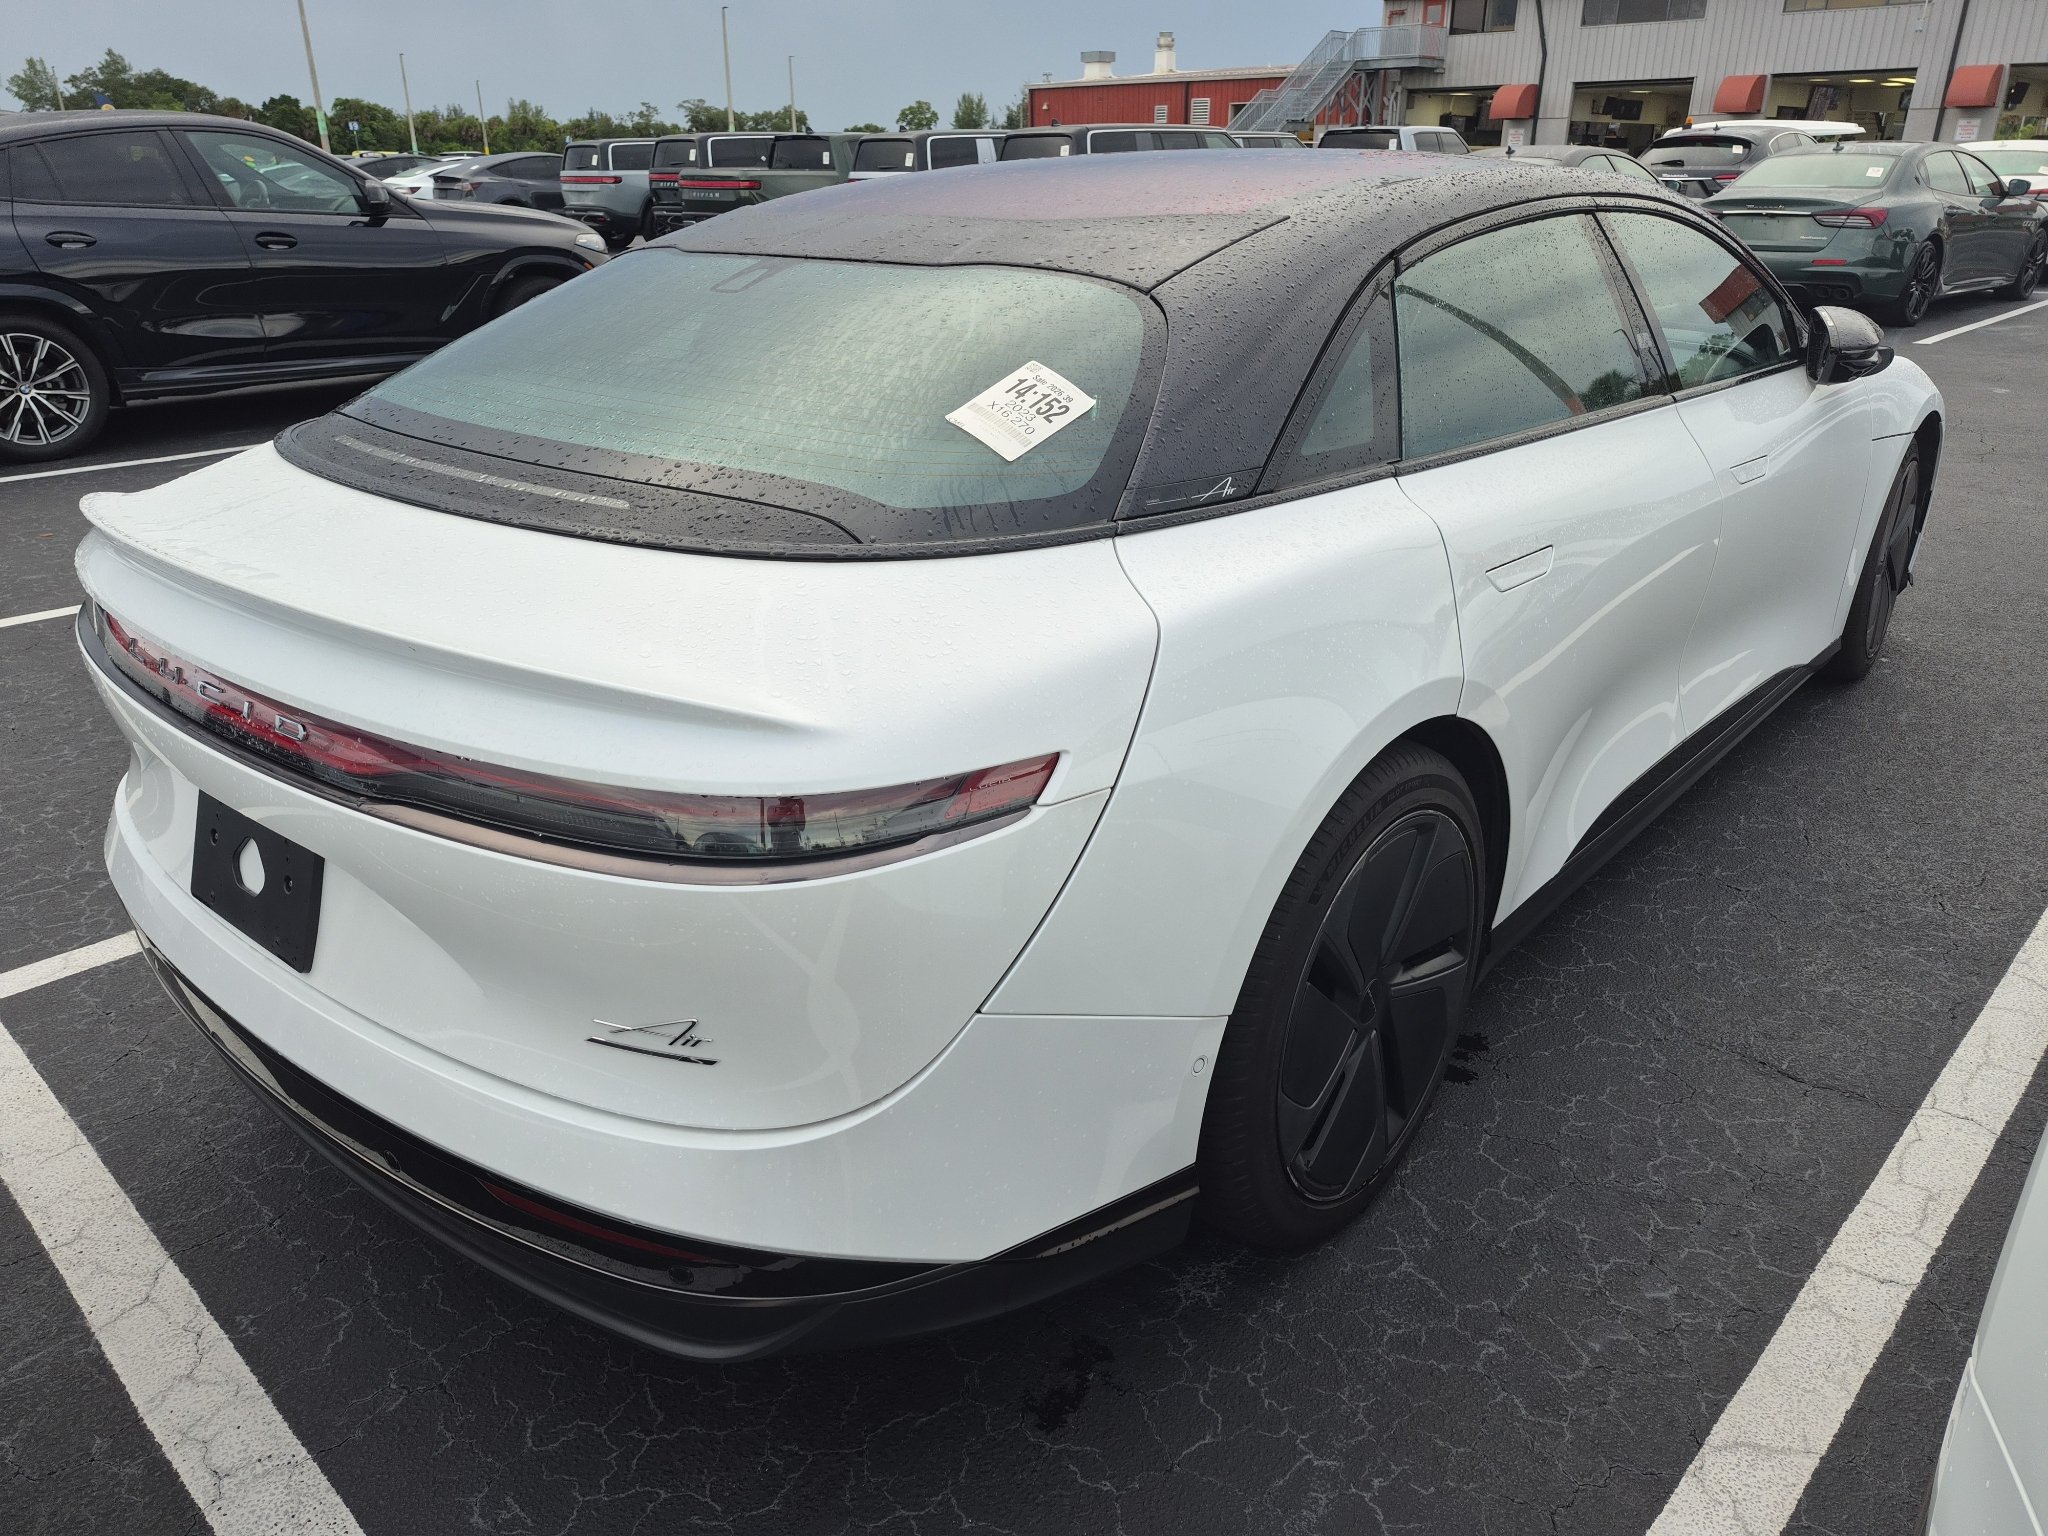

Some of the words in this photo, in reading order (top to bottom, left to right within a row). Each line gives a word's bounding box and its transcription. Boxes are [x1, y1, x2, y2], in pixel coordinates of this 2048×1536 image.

[1032, 374, 1048, 386] Sale
[1004, 400, 1037, 422] 2023
[1005, 378, 1070, 424] 14:152
[127, 637, 309, 743] LUCID
[592, 1017, 714, 1048] Air
